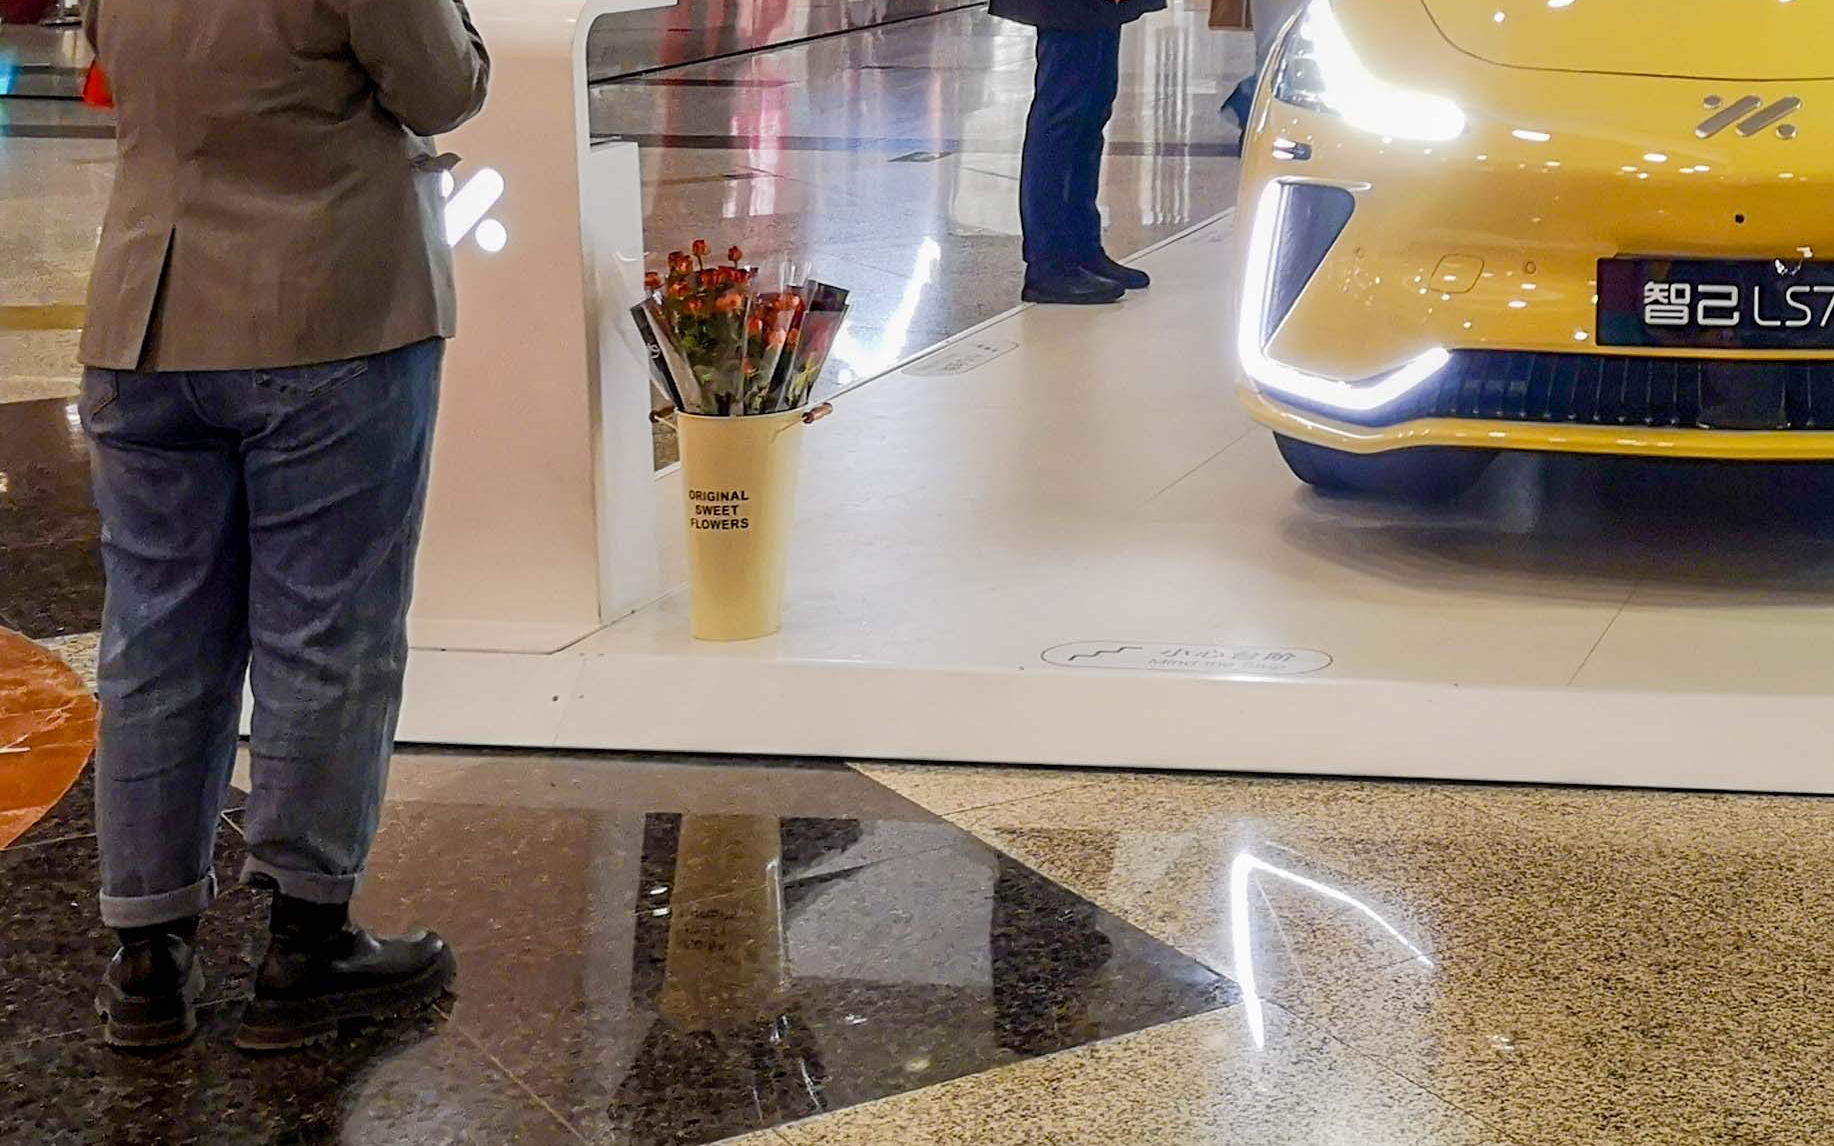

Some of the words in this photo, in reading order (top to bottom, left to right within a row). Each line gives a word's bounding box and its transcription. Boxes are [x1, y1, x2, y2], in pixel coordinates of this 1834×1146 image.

[1644, 281, 1740, 326] 智己
[689, 489, 749, 501] ORIGINAL
[696, 504, 739, 515] SWEET
[690, 518, 749, 530] FLOWERS
